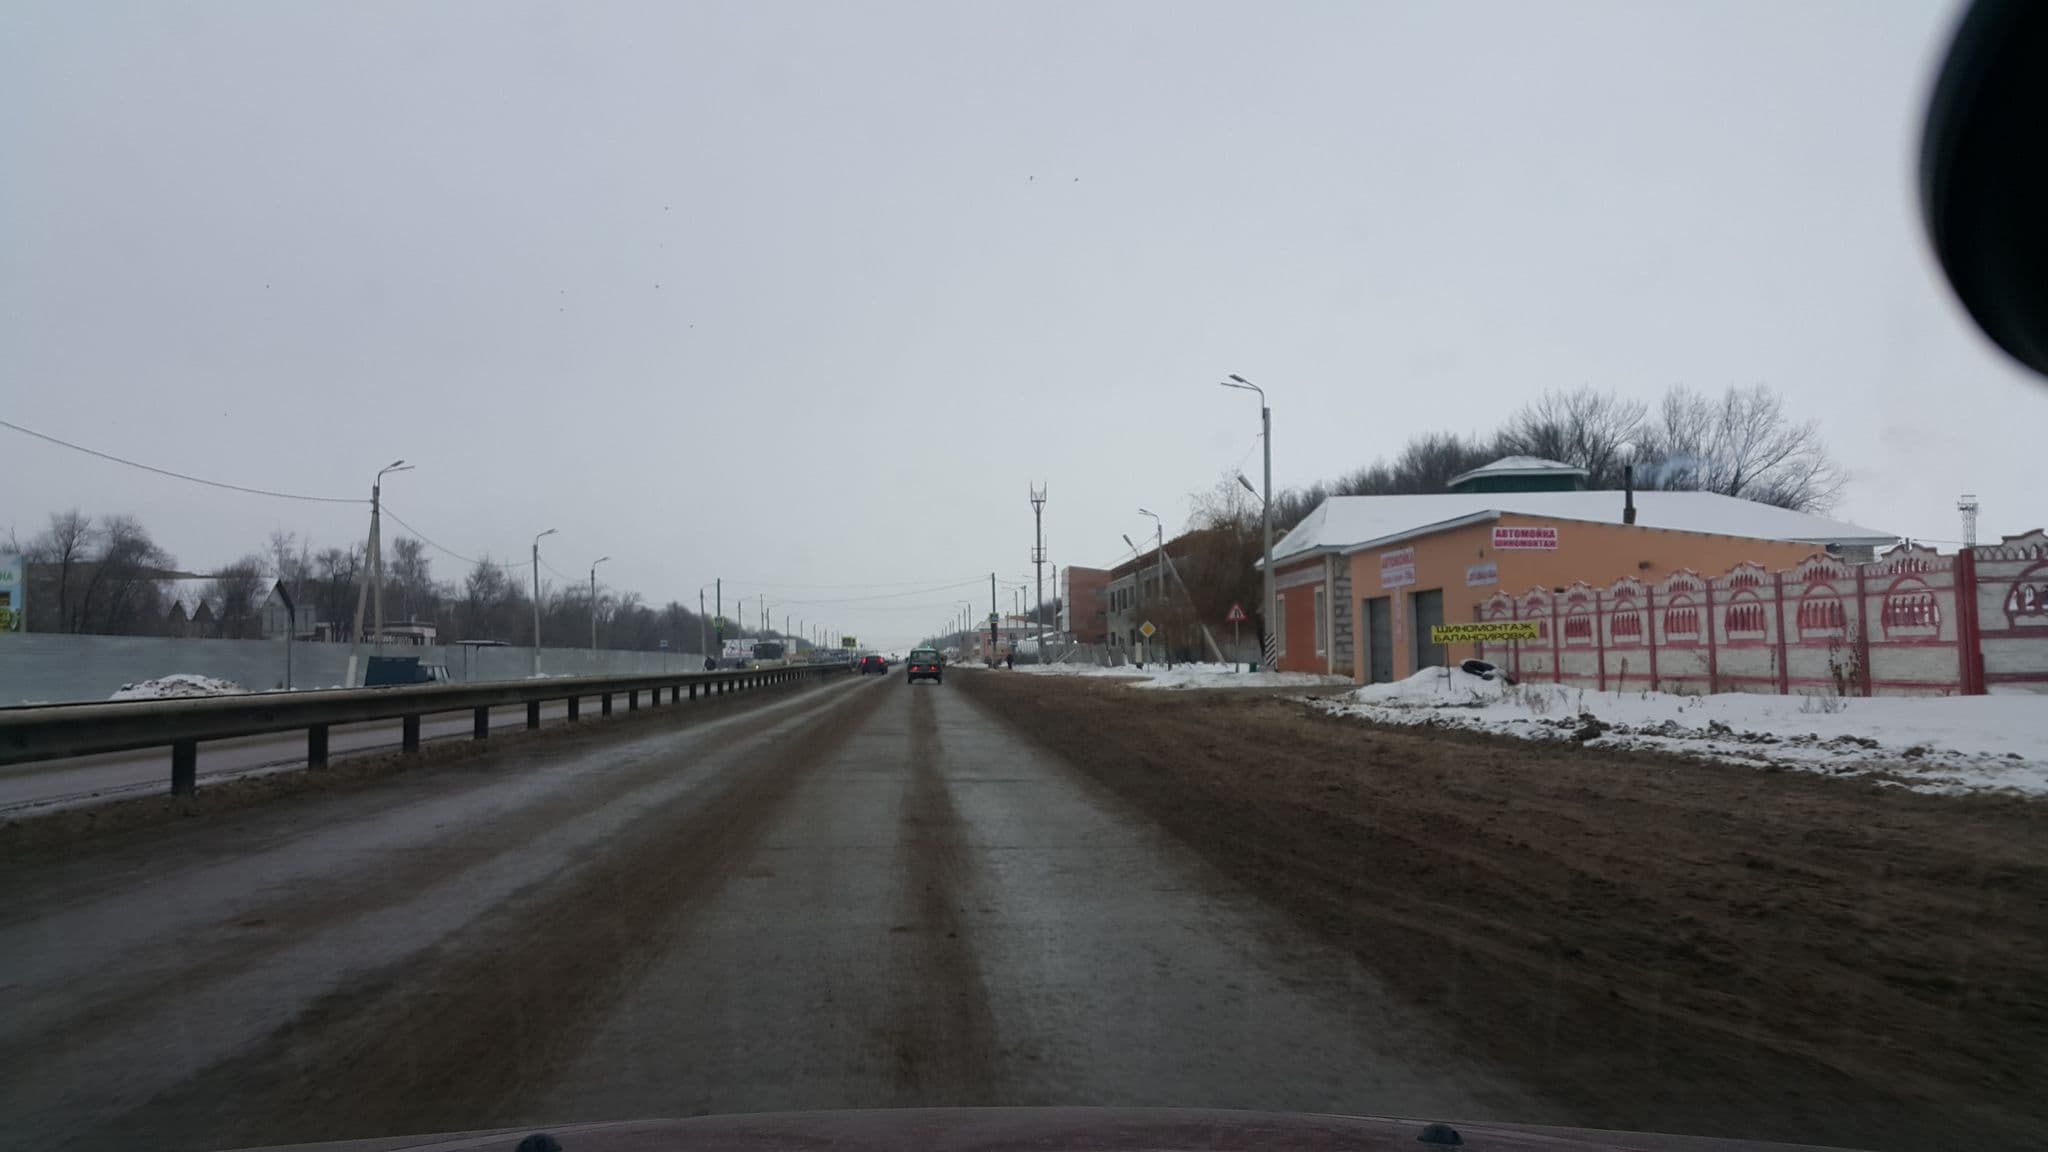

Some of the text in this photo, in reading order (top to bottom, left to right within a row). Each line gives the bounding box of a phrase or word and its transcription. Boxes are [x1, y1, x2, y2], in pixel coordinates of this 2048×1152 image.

[1495, 528, 1556, 538] АВТОМОЙКА
[1494, 539, 1557, 548] ШИНОМОНТАЖ
[1436, 623, 1533, 633] ШИНОМОНТАЖ
[1433, 632, 1537, 643] БАЛАНСИРОВКА
